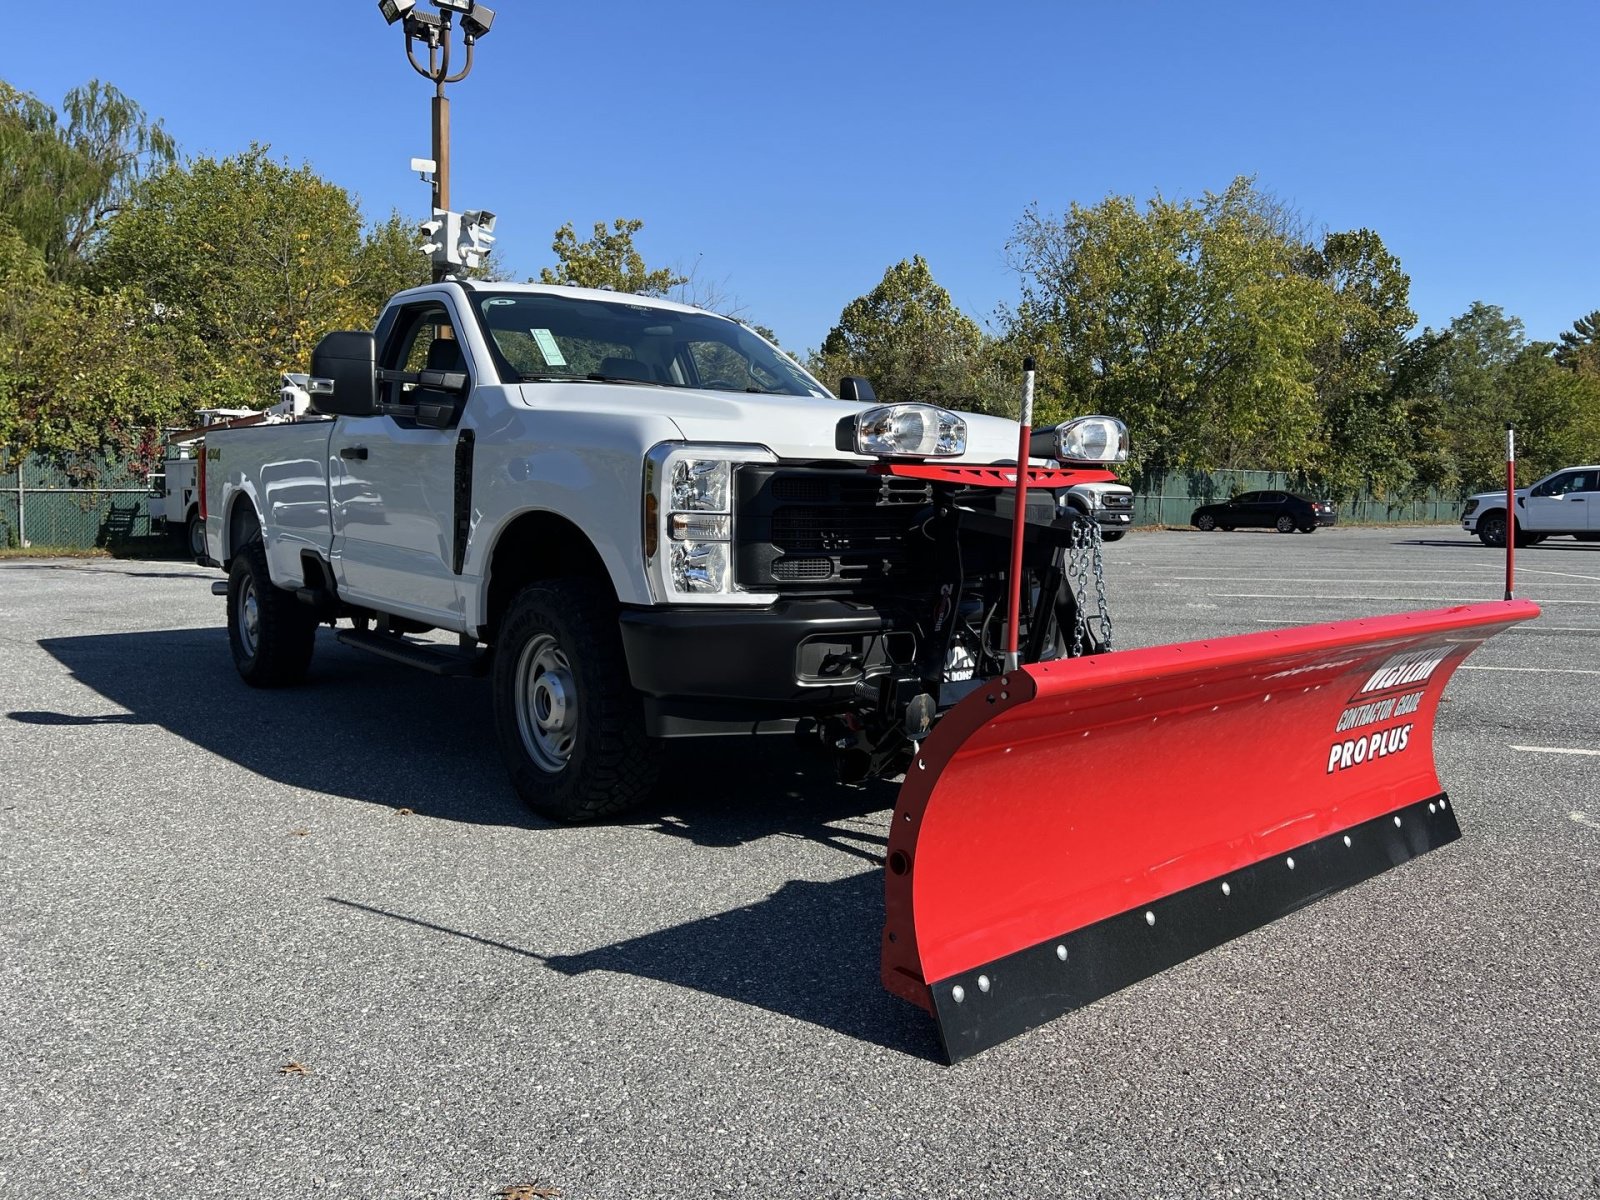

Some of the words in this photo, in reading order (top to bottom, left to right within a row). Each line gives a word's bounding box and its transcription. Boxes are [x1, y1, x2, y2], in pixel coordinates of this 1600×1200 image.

[1335, 698, 1397, 733] CONTRACTOR
[1394, 691, 1425, 718] GRADE
[1327, 737, 1368, 774] PRO
[1367, 724, 1410, 761] PLUS
